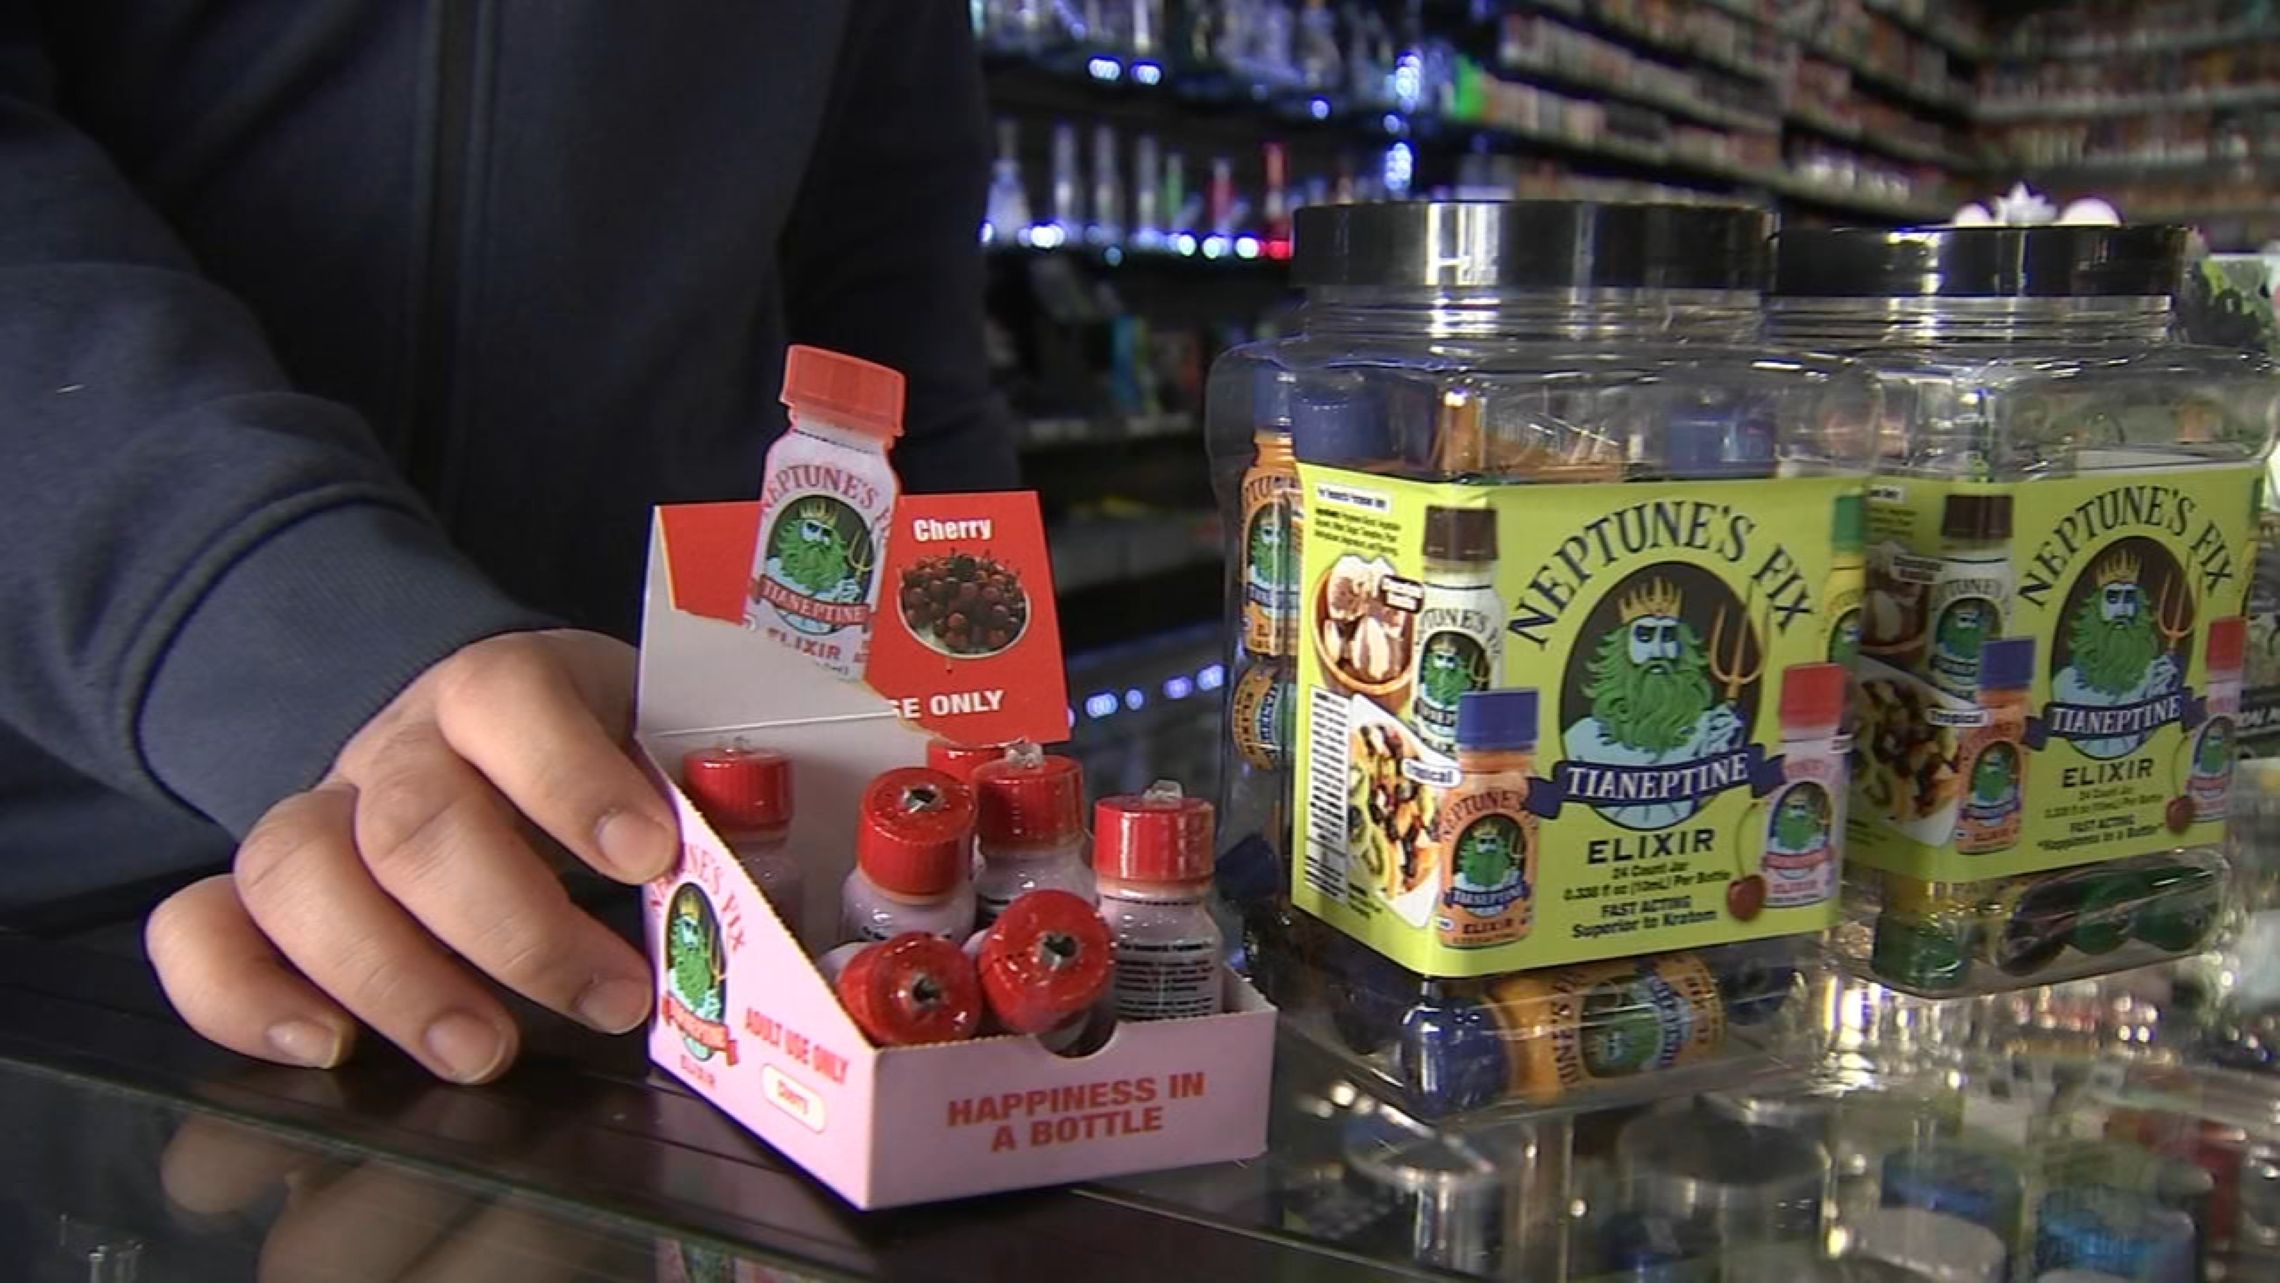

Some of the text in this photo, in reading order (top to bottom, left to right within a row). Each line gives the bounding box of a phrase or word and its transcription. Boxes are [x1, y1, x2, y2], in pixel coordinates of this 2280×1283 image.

[913, 518, 993, 542] Cherry
[2018, 485, 2234, 609] NEPTUNE'S FIX
[1506, 500, 1757, 647] NEPTUNE'S
[1751, 544, 1814, 634] FIX
[763, 581, 865, 623] TIANEPTINE
[929, 689, 1005, 716] ONLY
[2052, 696, 2180, 733] TIANEPTINE
[1567, 753, 1749, 799] TIANEPTINE
[2062, 758, 2154, 788] ELIXIR
[1587, 829, 1715, 864] ELIXIR
[1631, 863, 1668, 878] Count
[1674, 874, 1694, 887] Per
[1696, 870, 1732, 884] Bottle
[1572, 909, 1718, 939] Superior to Kratom
[1601, 895, 1692, 918] FAST ACTING
[947, 1072, 1206, 1127] HAPPINESS IN
[991, 1106, 1163, 1152] A BOTTLE
